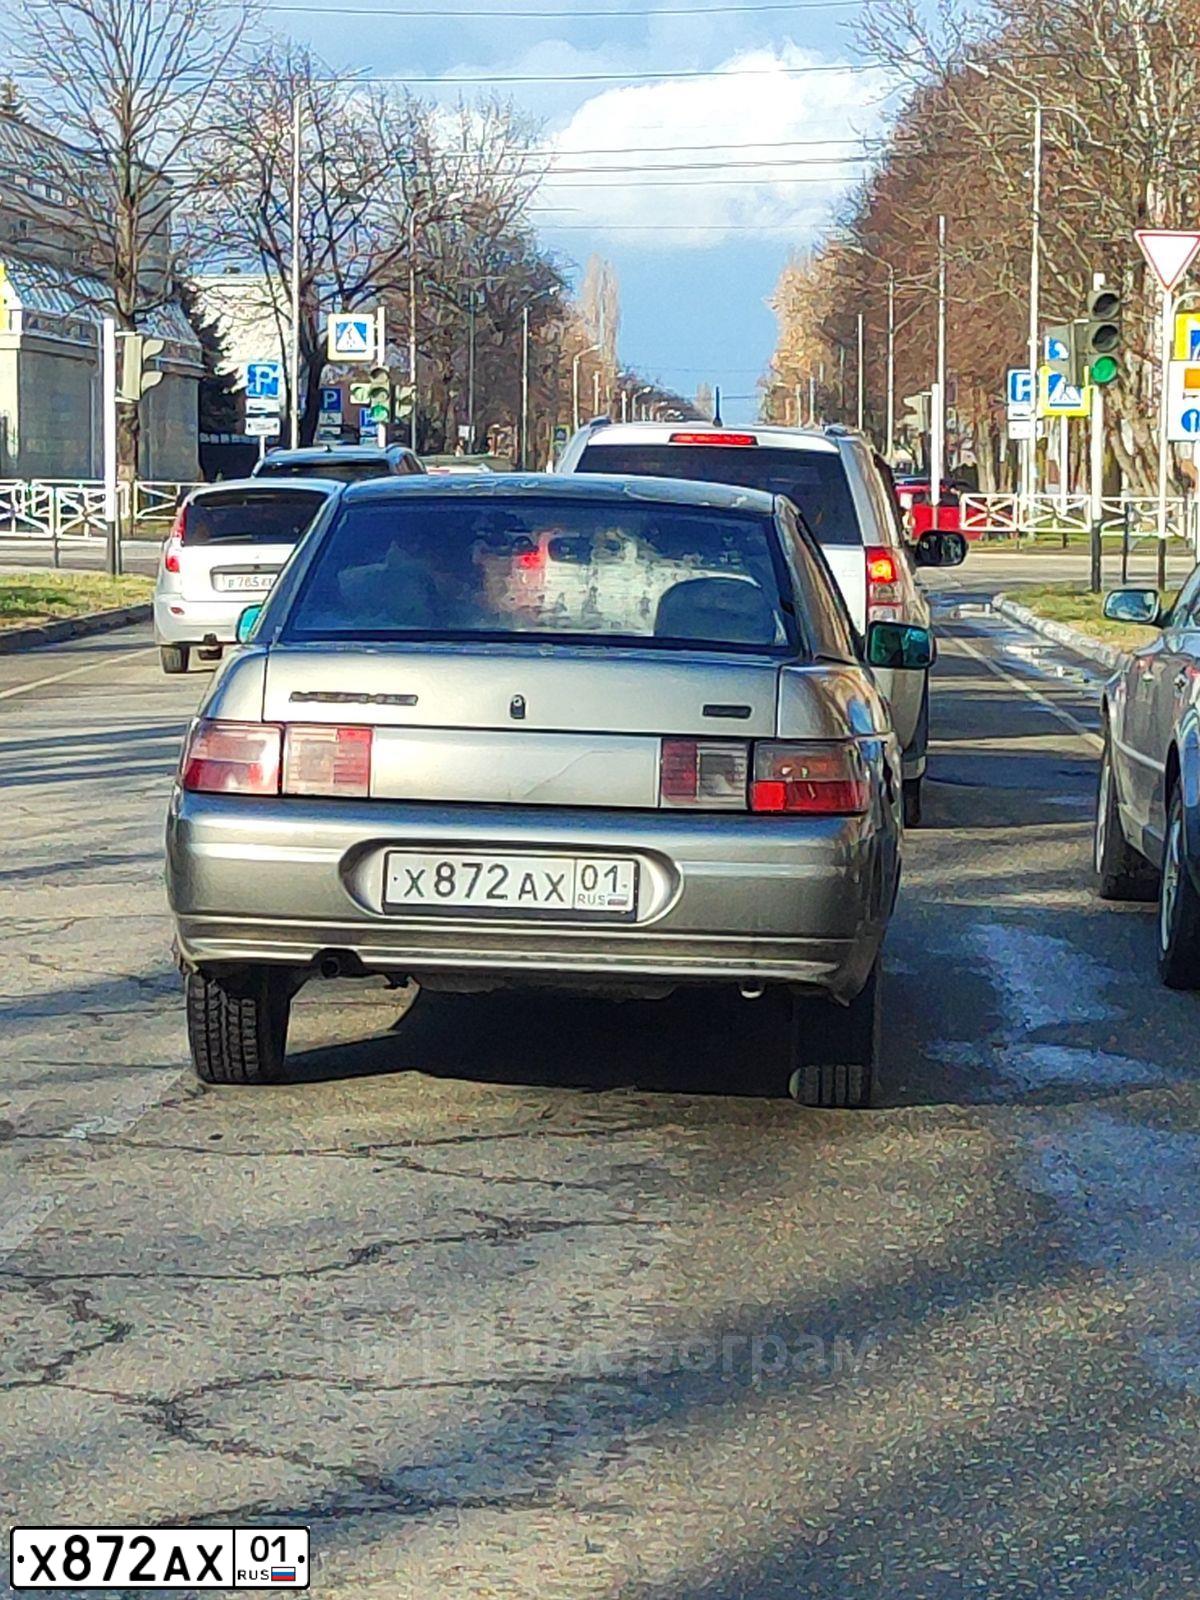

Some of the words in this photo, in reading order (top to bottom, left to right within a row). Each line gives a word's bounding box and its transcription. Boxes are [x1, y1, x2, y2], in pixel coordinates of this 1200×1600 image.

[404, 861, 566, 902] Х872АХ
[580, 864, 619, 892] 01
[577, 893, 606, 906] RUS
